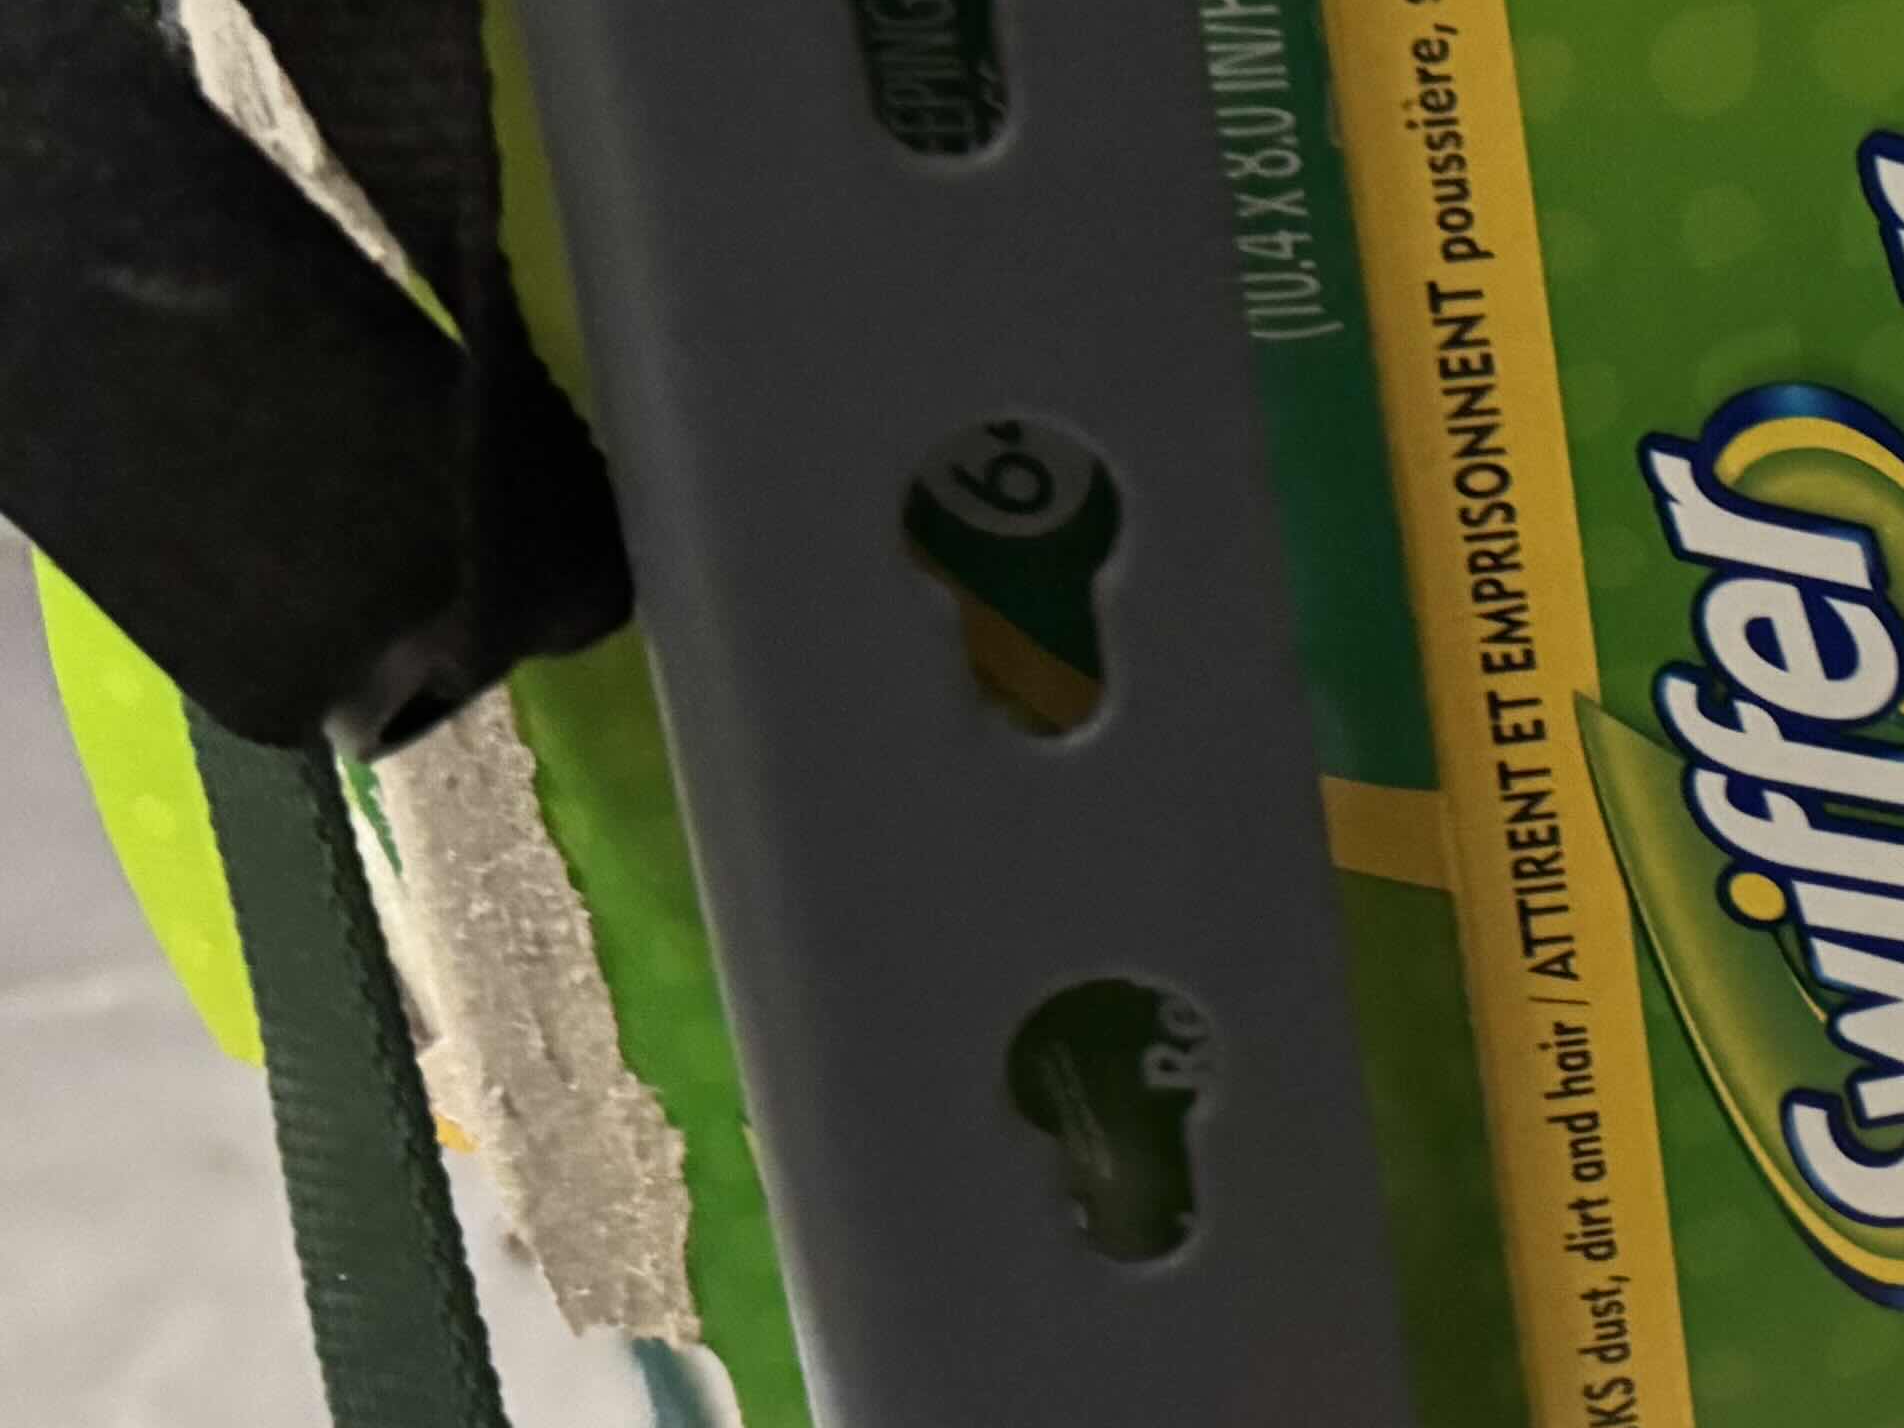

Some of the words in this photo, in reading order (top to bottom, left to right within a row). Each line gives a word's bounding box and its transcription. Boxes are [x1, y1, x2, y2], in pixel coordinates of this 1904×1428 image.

[1403, 19, 1494, 262] poussière,
[1427, 279, 1537, 675] EMPRISONNENT
[1487, 691, 1546, 746] ET
[1494, 762, 1581, 982] ATTIRENT
[1540, 1018, 1597, 1099] hair
[1546, 1111, 1606, 1183] and
[1562, 1196, 1617, 1261] dirt
[1572, 1274, 1634, 1364] dust,
